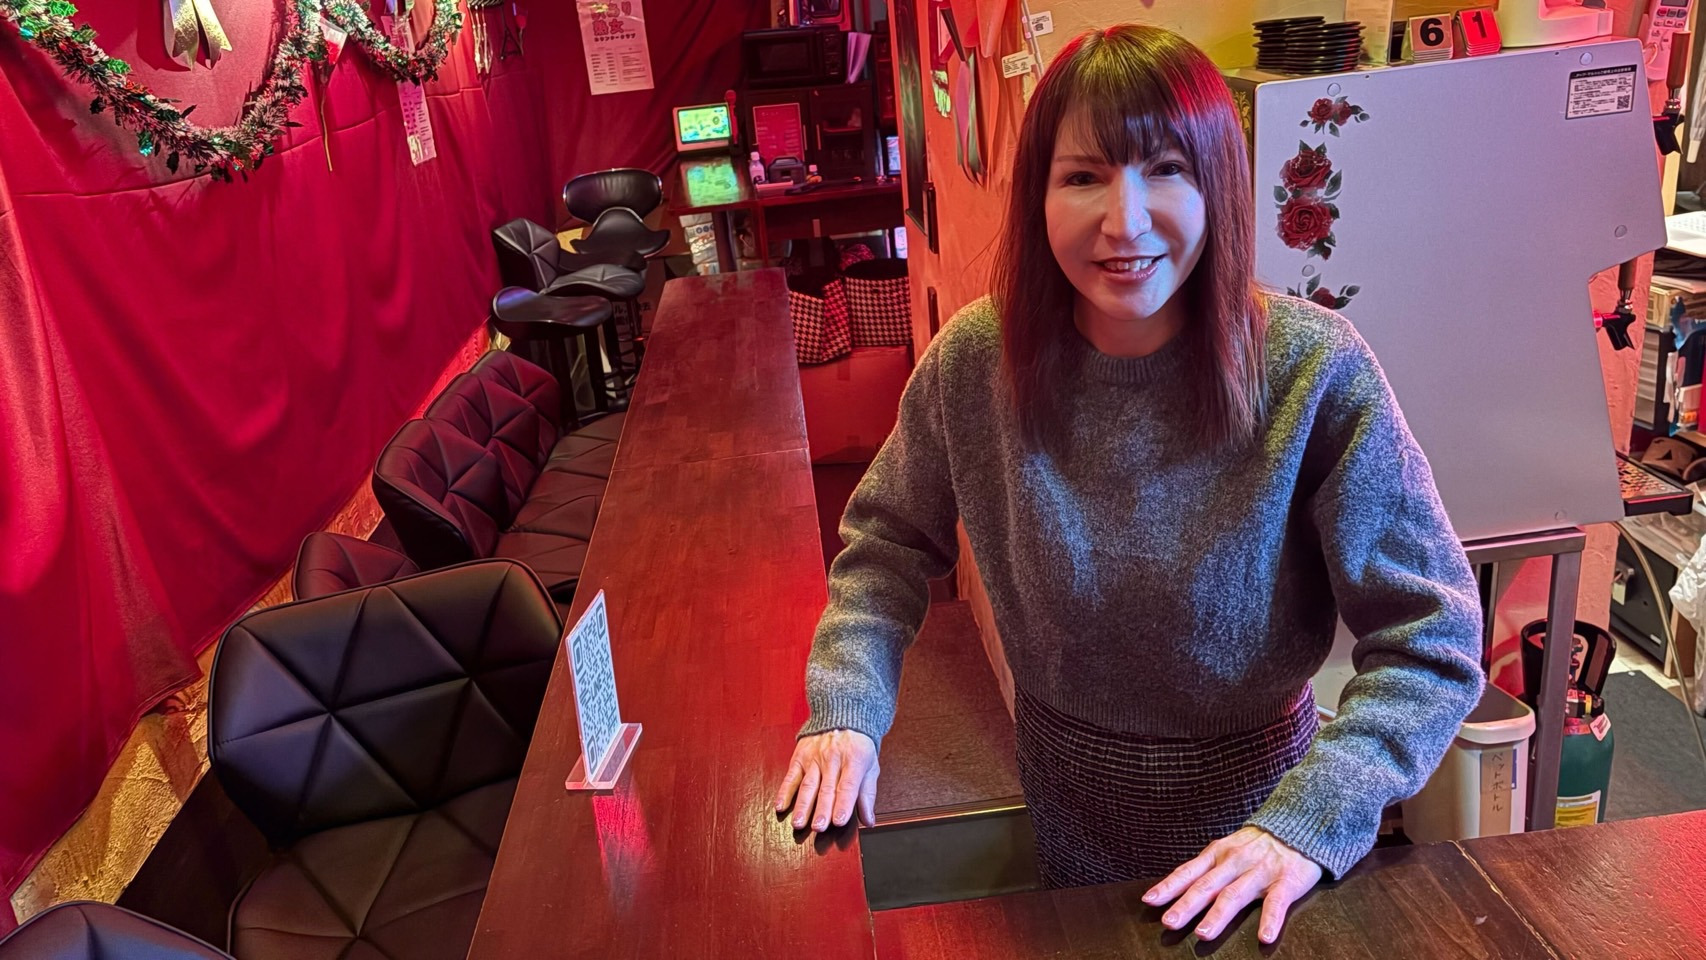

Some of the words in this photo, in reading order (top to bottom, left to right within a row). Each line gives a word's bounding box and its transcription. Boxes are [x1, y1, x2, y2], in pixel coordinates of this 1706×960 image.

[592, 18, 624, 36] 熟女
[1420, 18, 1444, 46] 6
[1472, 10, 1487, 38] 1
[1492, 752, 1505, 812] ペットボトル
